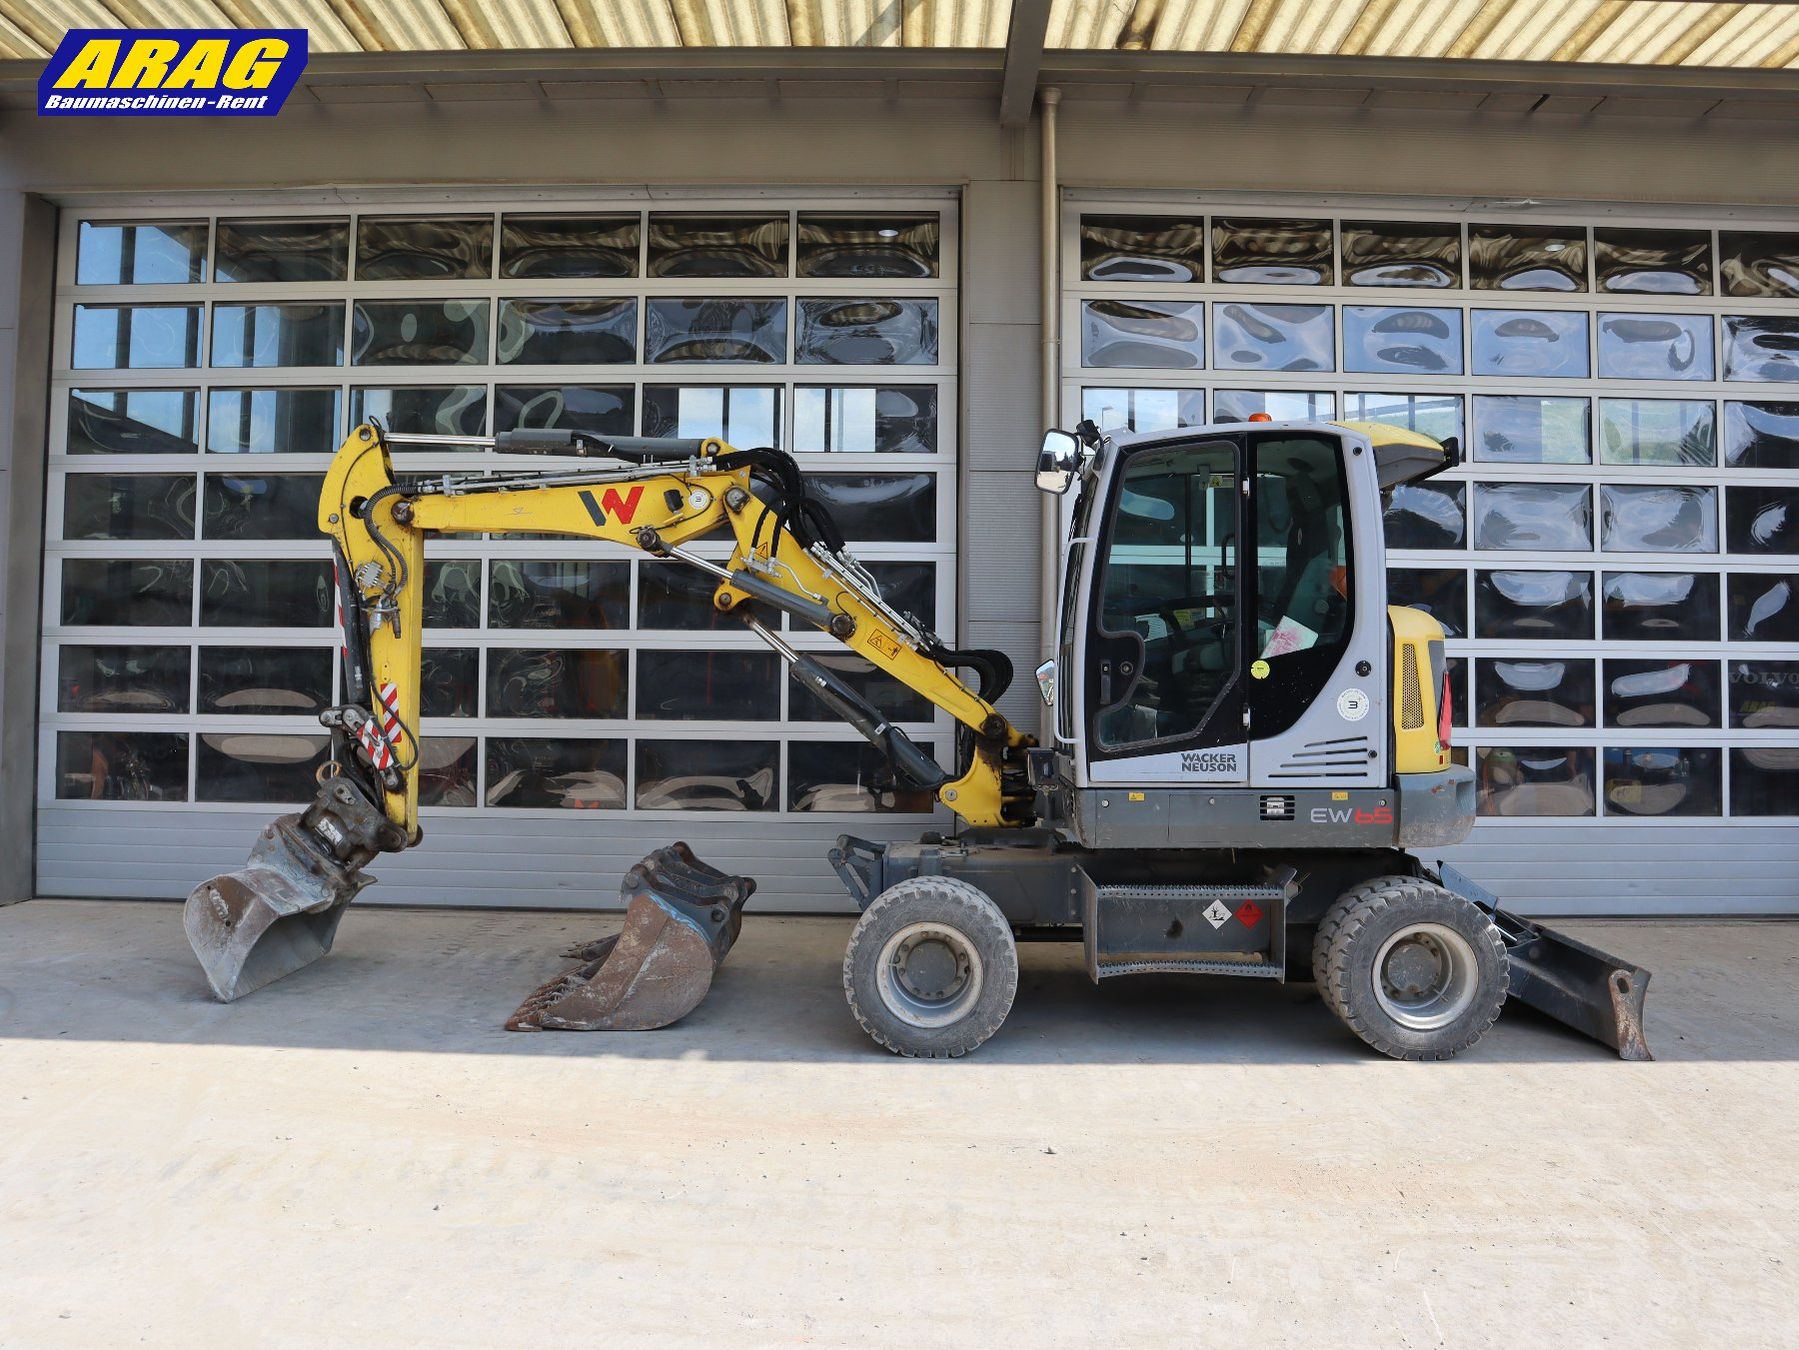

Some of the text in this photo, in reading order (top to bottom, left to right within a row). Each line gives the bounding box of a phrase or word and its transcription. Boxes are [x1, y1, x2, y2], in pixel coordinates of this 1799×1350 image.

[1728, 671, 1799, 685] VOLVO
[1180, 753, 1236, 762] WACKER
[1181, 763, 1237, 772] NEUSON
